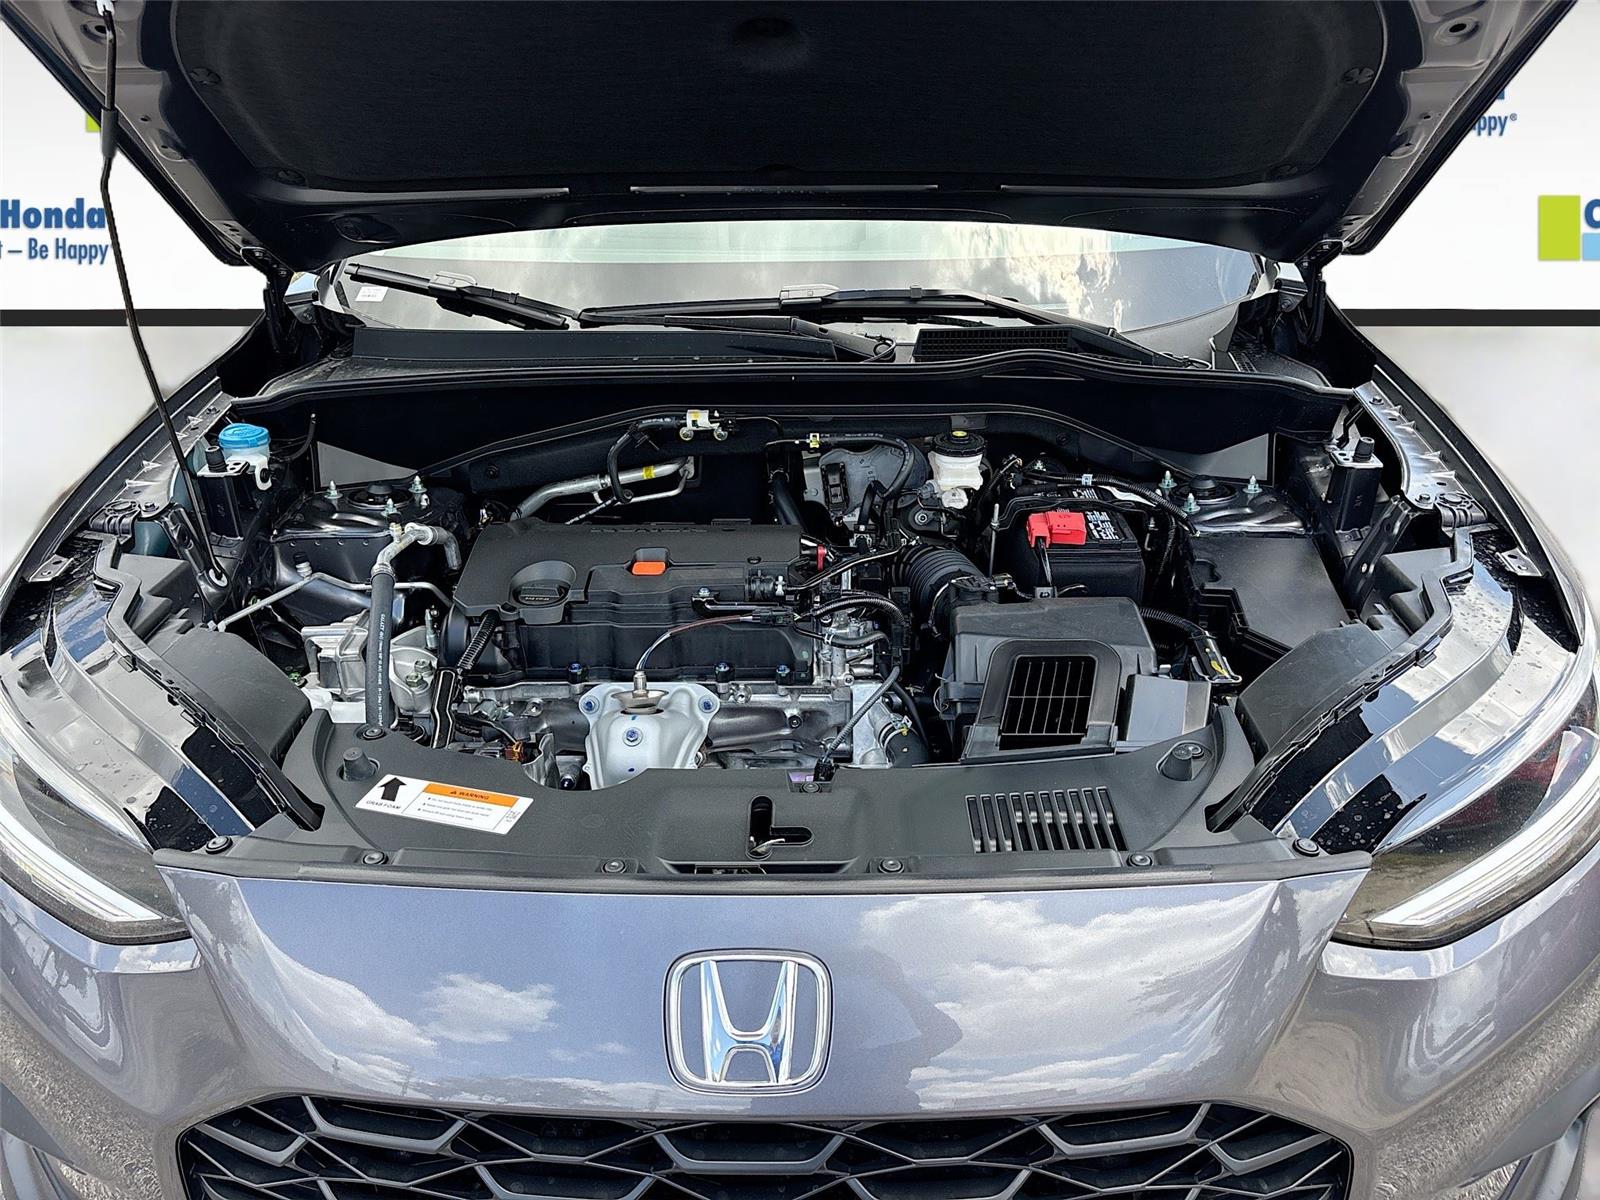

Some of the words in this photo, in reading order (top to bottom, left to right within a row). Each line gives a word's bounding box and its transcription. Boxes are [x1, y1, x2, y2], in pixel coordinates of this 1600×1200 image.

[1472, 113, 1518, 137] ppy®
[0, 197, 105, 229] Honda
[27, 237, 49, 260] Be
[54, 237, 110, 265] Happy
[459, 791, 490, 800] WARNING
